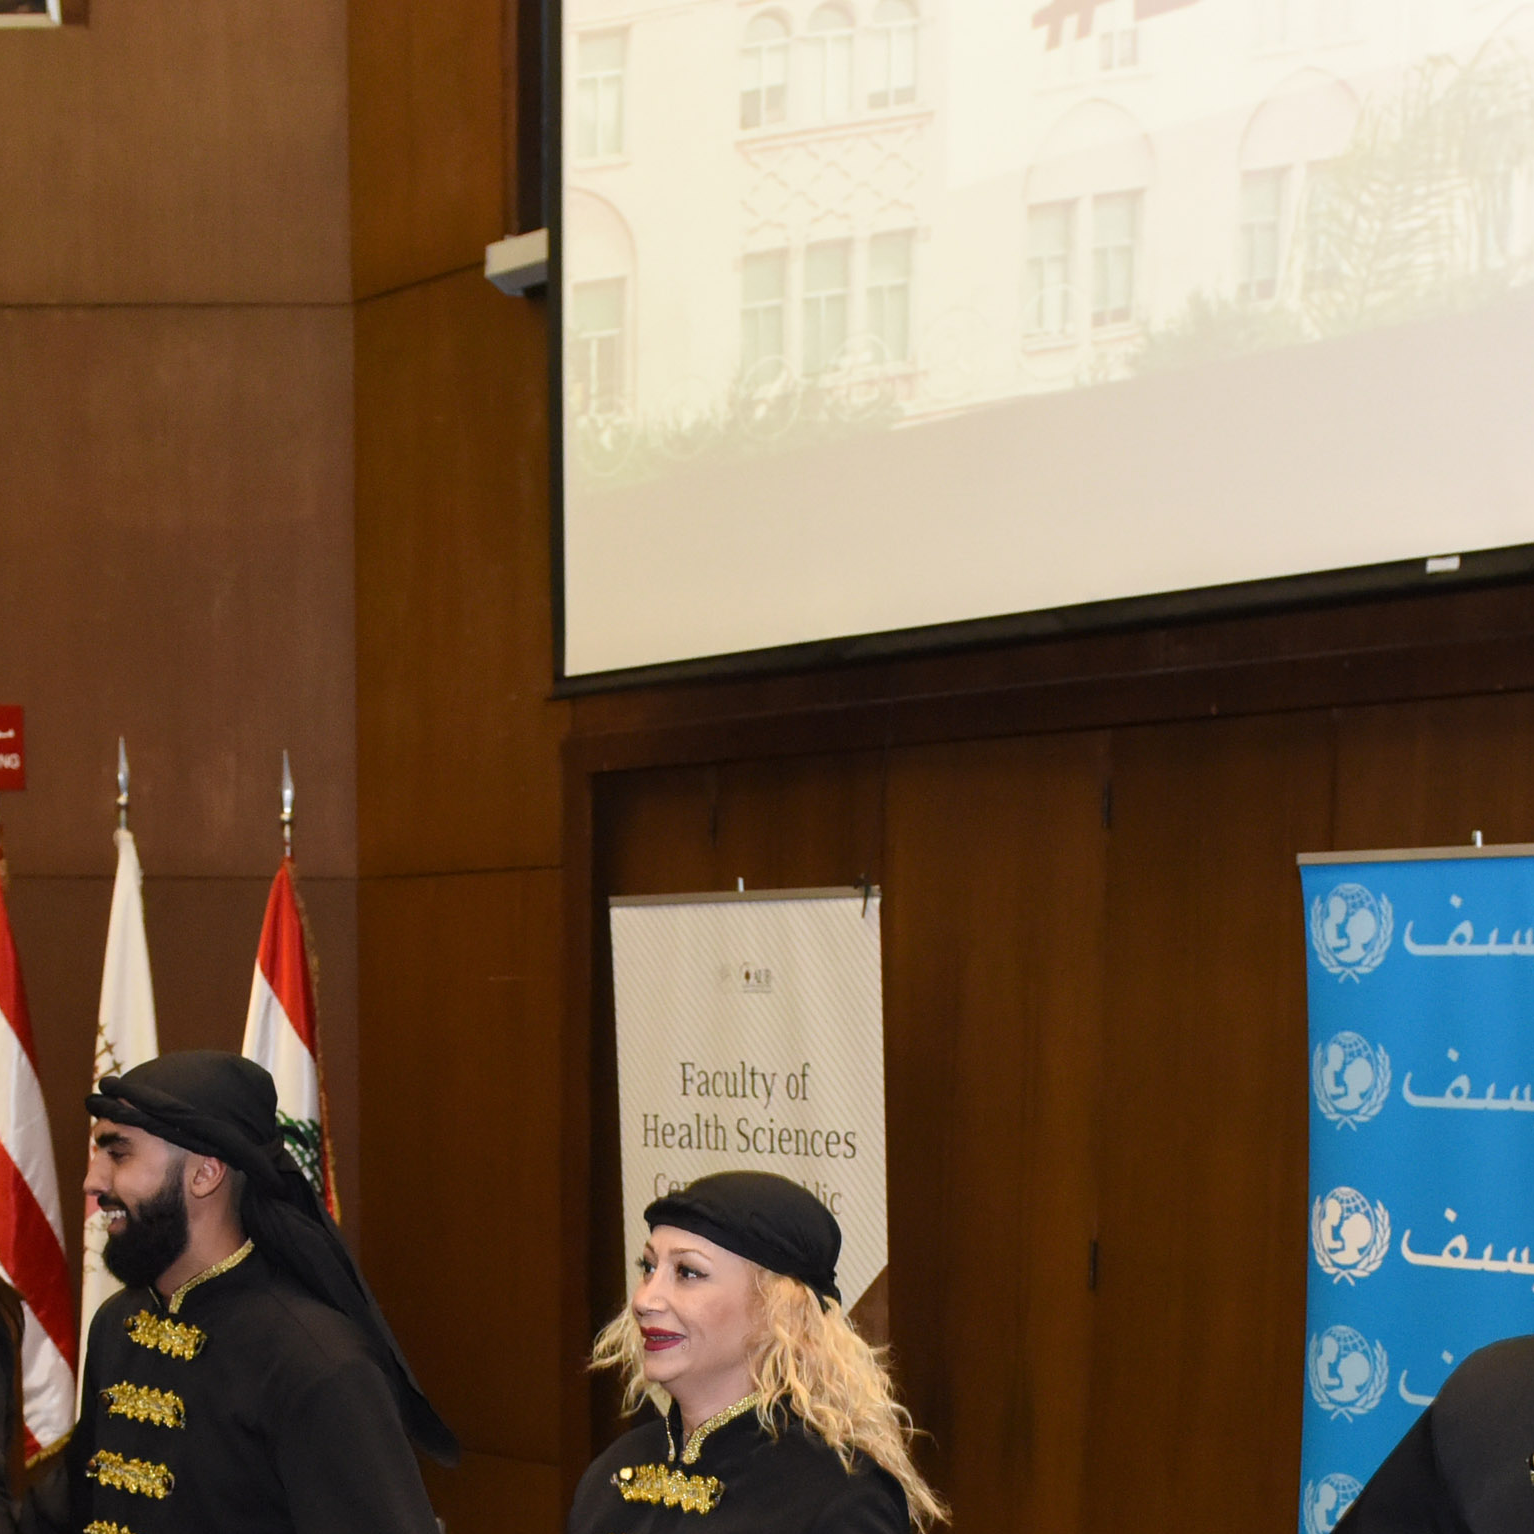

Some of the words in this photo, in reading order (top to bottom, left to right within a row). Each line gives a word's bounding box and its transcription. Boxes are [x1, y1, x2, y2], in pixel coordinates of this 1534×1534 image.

[679, 1060, 777, 1110] Faculty
[785, 1062, 811, 1101] of
[642, 1112, 728, 1152] Health
[736, 1116, 857, 1160] Sciences
